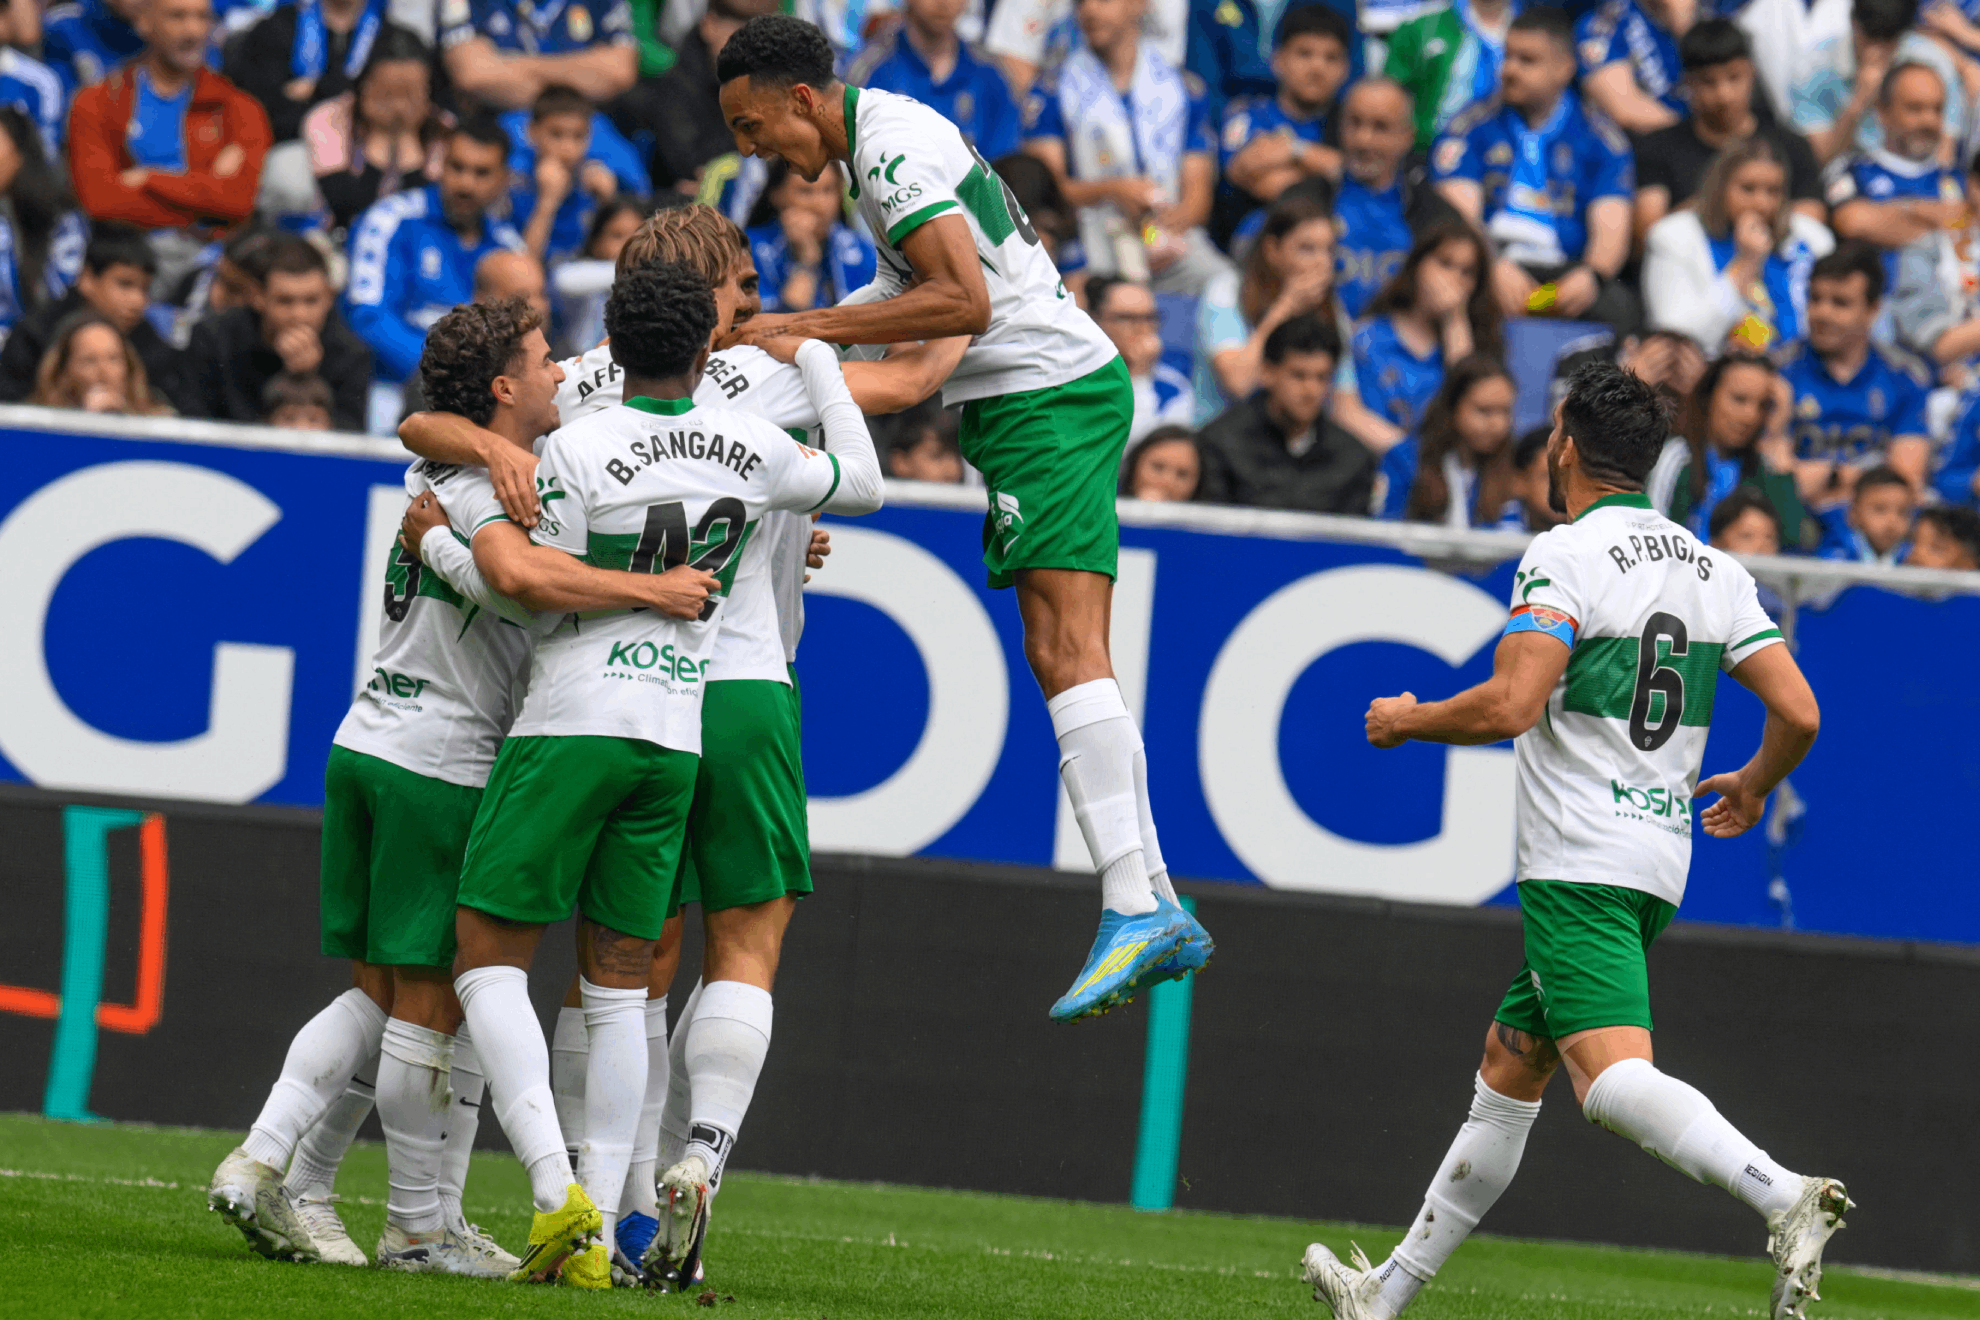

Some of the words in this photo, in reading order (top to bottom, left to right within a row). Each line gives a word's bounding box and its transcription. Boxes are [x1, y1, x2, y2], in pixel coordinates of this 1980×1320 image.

[881, 182, 923, 215] MGS
[605, 431, 763, 487] B.SANGARE
[539, 517, 560, 536] GS
[628, 496, 747, 622] 42
[1628, 611, 1689, 752] 6
